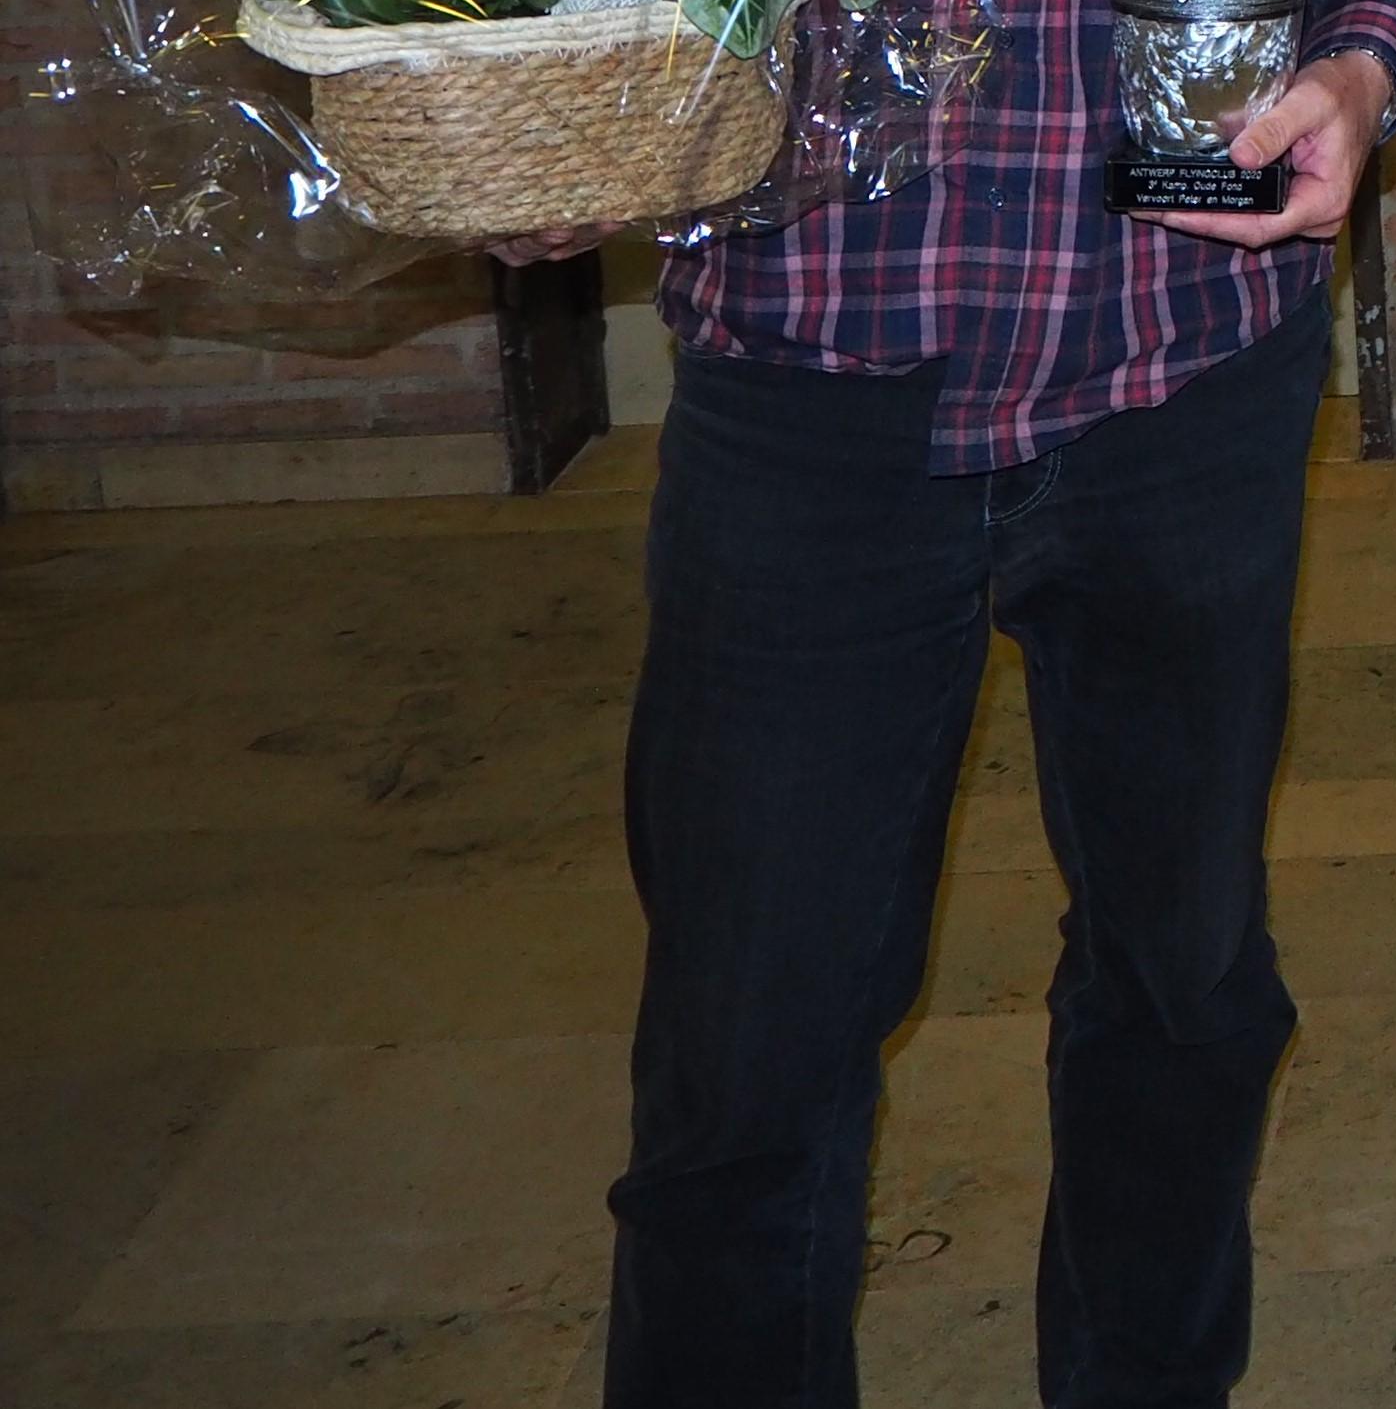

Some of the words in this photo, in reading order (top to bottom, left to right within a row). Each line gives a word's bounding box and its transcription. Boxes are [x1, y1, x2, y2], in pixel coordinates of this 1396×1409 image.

[1129, 168, 1175, 178] ANTWERP
[1193, 181, 1217, 191] Oude
[1221, 181, 1243, 191] Fond
[1179, 194, 1202, 204] Peter
[1206, 196, 1218, 204] en
